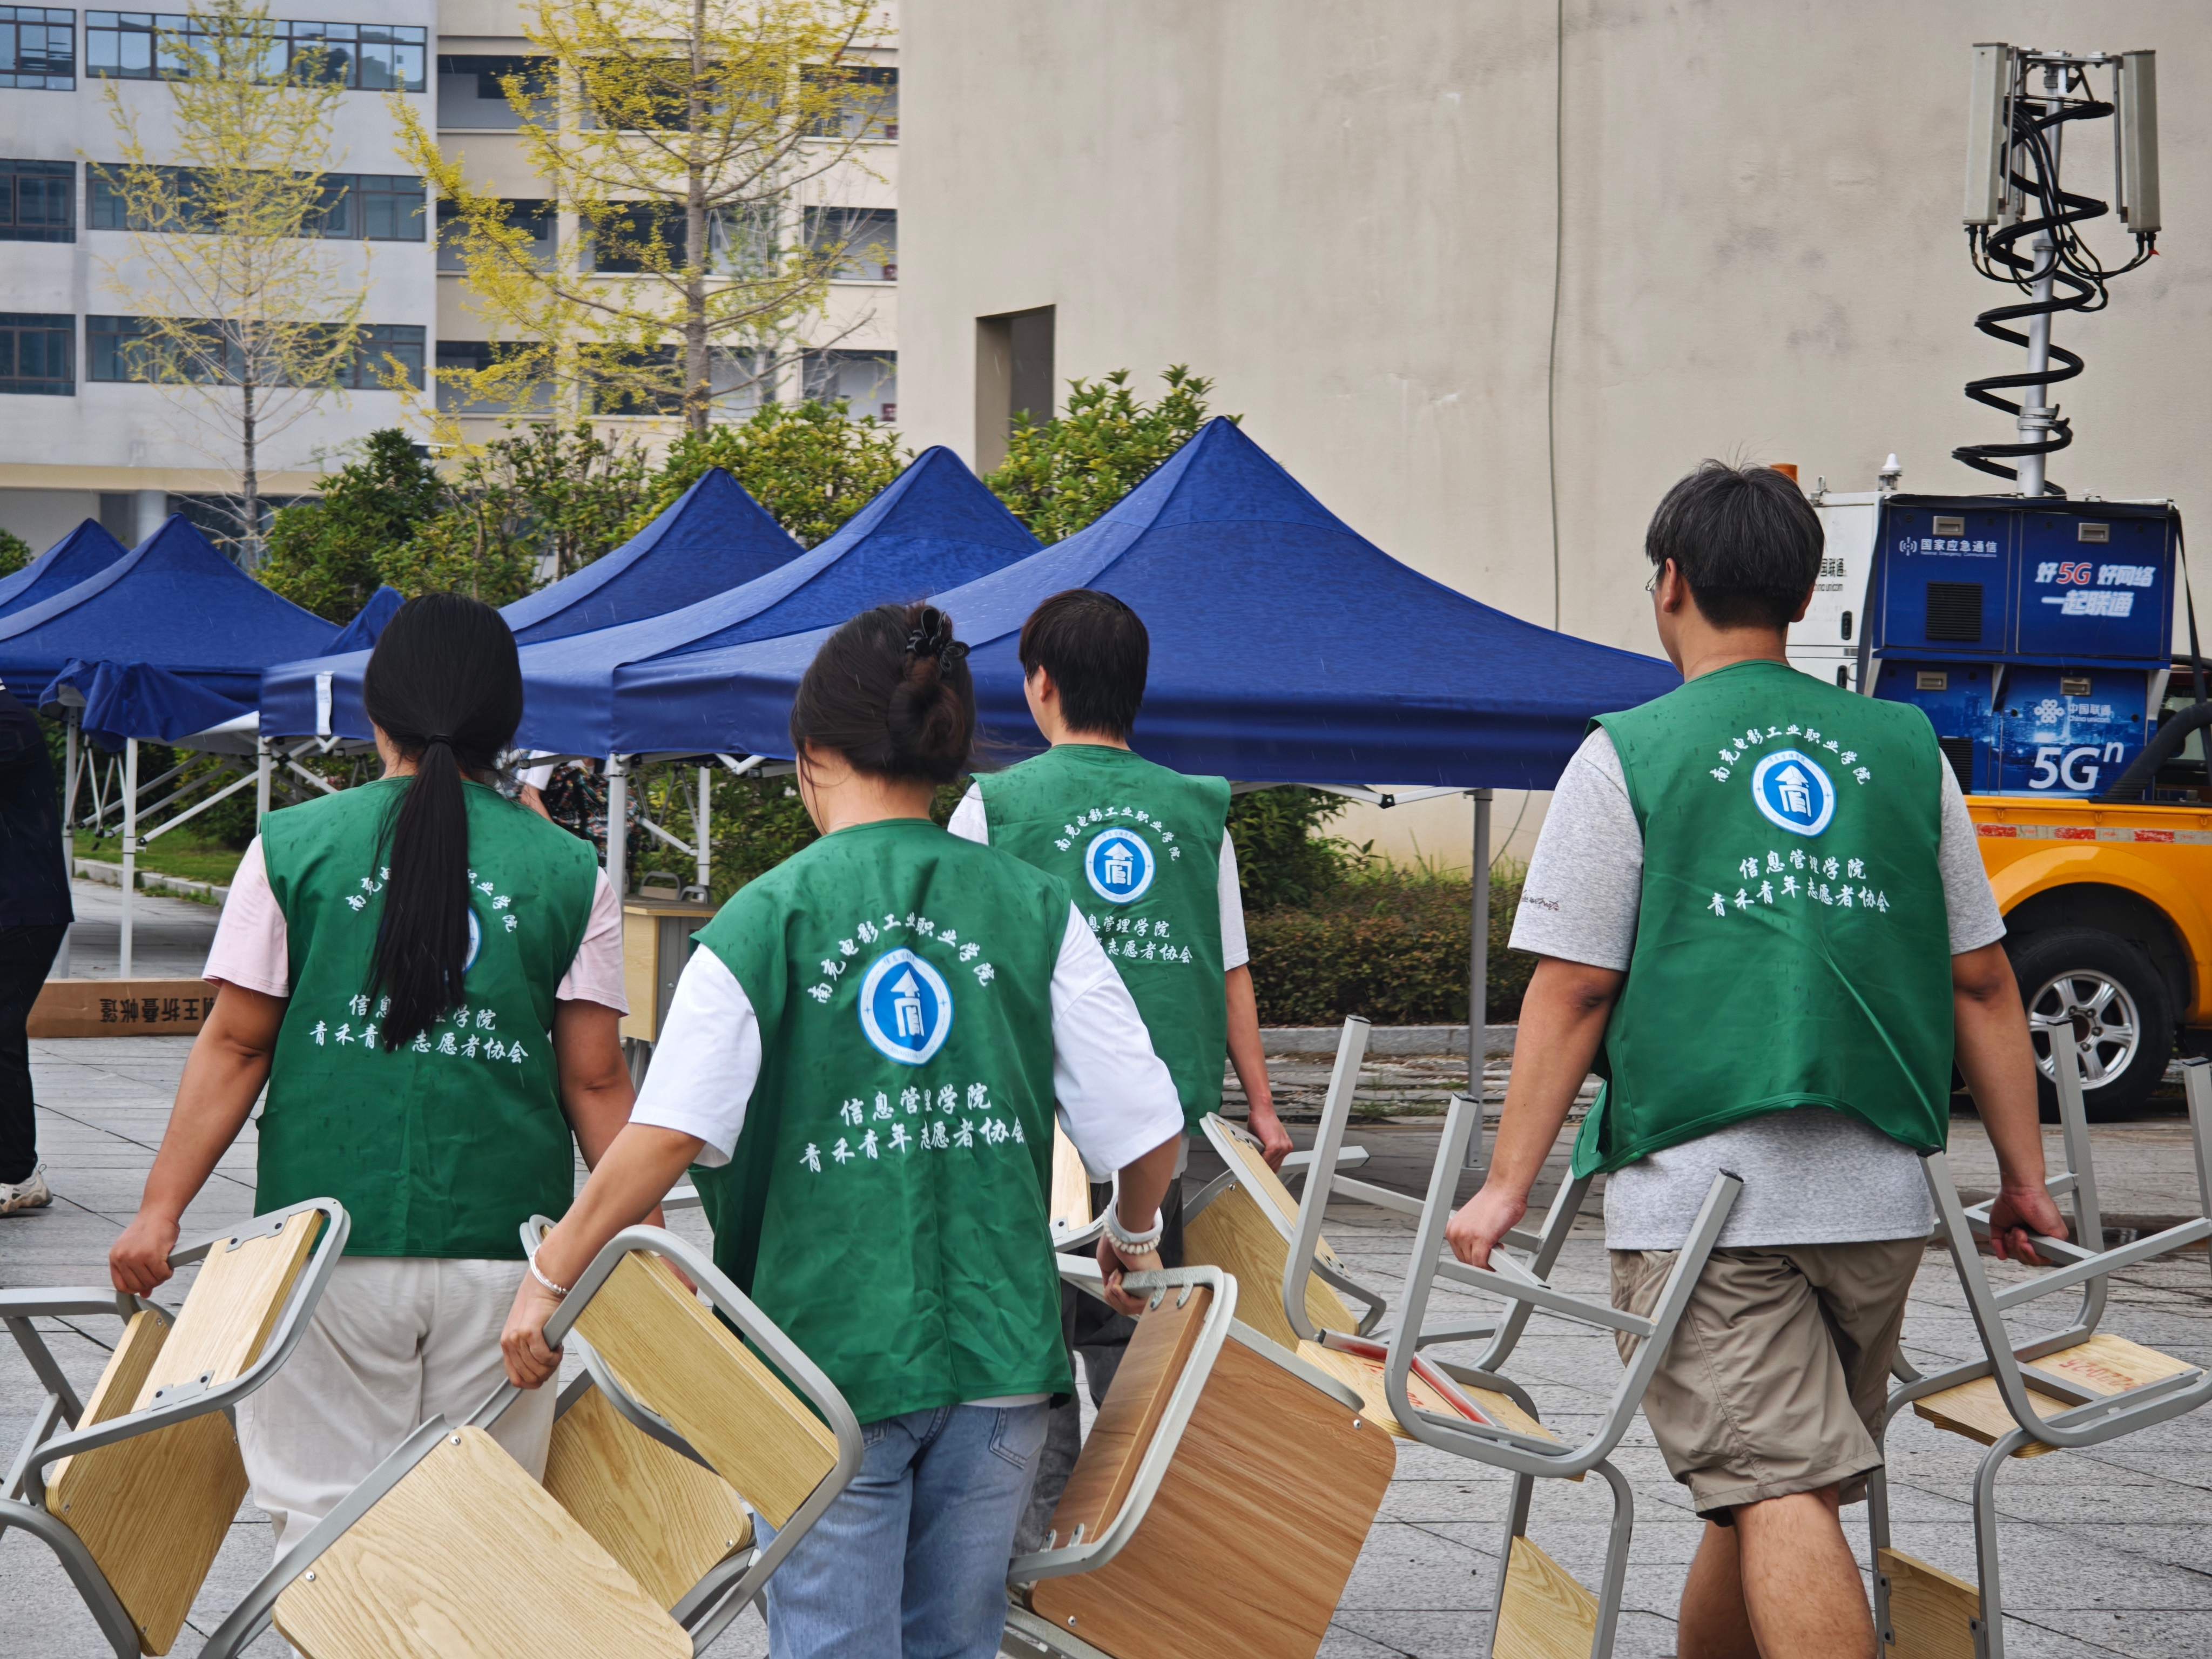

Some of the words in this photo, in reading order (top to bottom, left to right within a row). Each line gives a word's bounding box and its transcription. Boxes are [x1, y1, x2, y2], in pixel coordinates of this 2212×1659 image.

[1921, 538, 1998, 553] 国家应急通信
[2035, 562, 2092, 585] 好5G
[2096, 564, 2156, 587] 好网络
[2041, 589, 2134, 617] 一起联通
[1709, 724, 1871, 785] 南充电影工业职业学院
[1054, 806, 1181, 861] 南充电影工业职业学院
[1738, 848, 1867, 880] 信息管理学院
[1707, 874, 1890, 917] 青禾青年志愿者协会
[1088, 913, 1170, 938] 息管理学院
[807, 912, 995, 1004] 南充电影工业职业学院
[1097, 936, 1193, 963] 志愿者协会
[349, 994, 497, 1030] 信息学院
[309, 1020, 528, 1064] 青禾青志愿者协会
